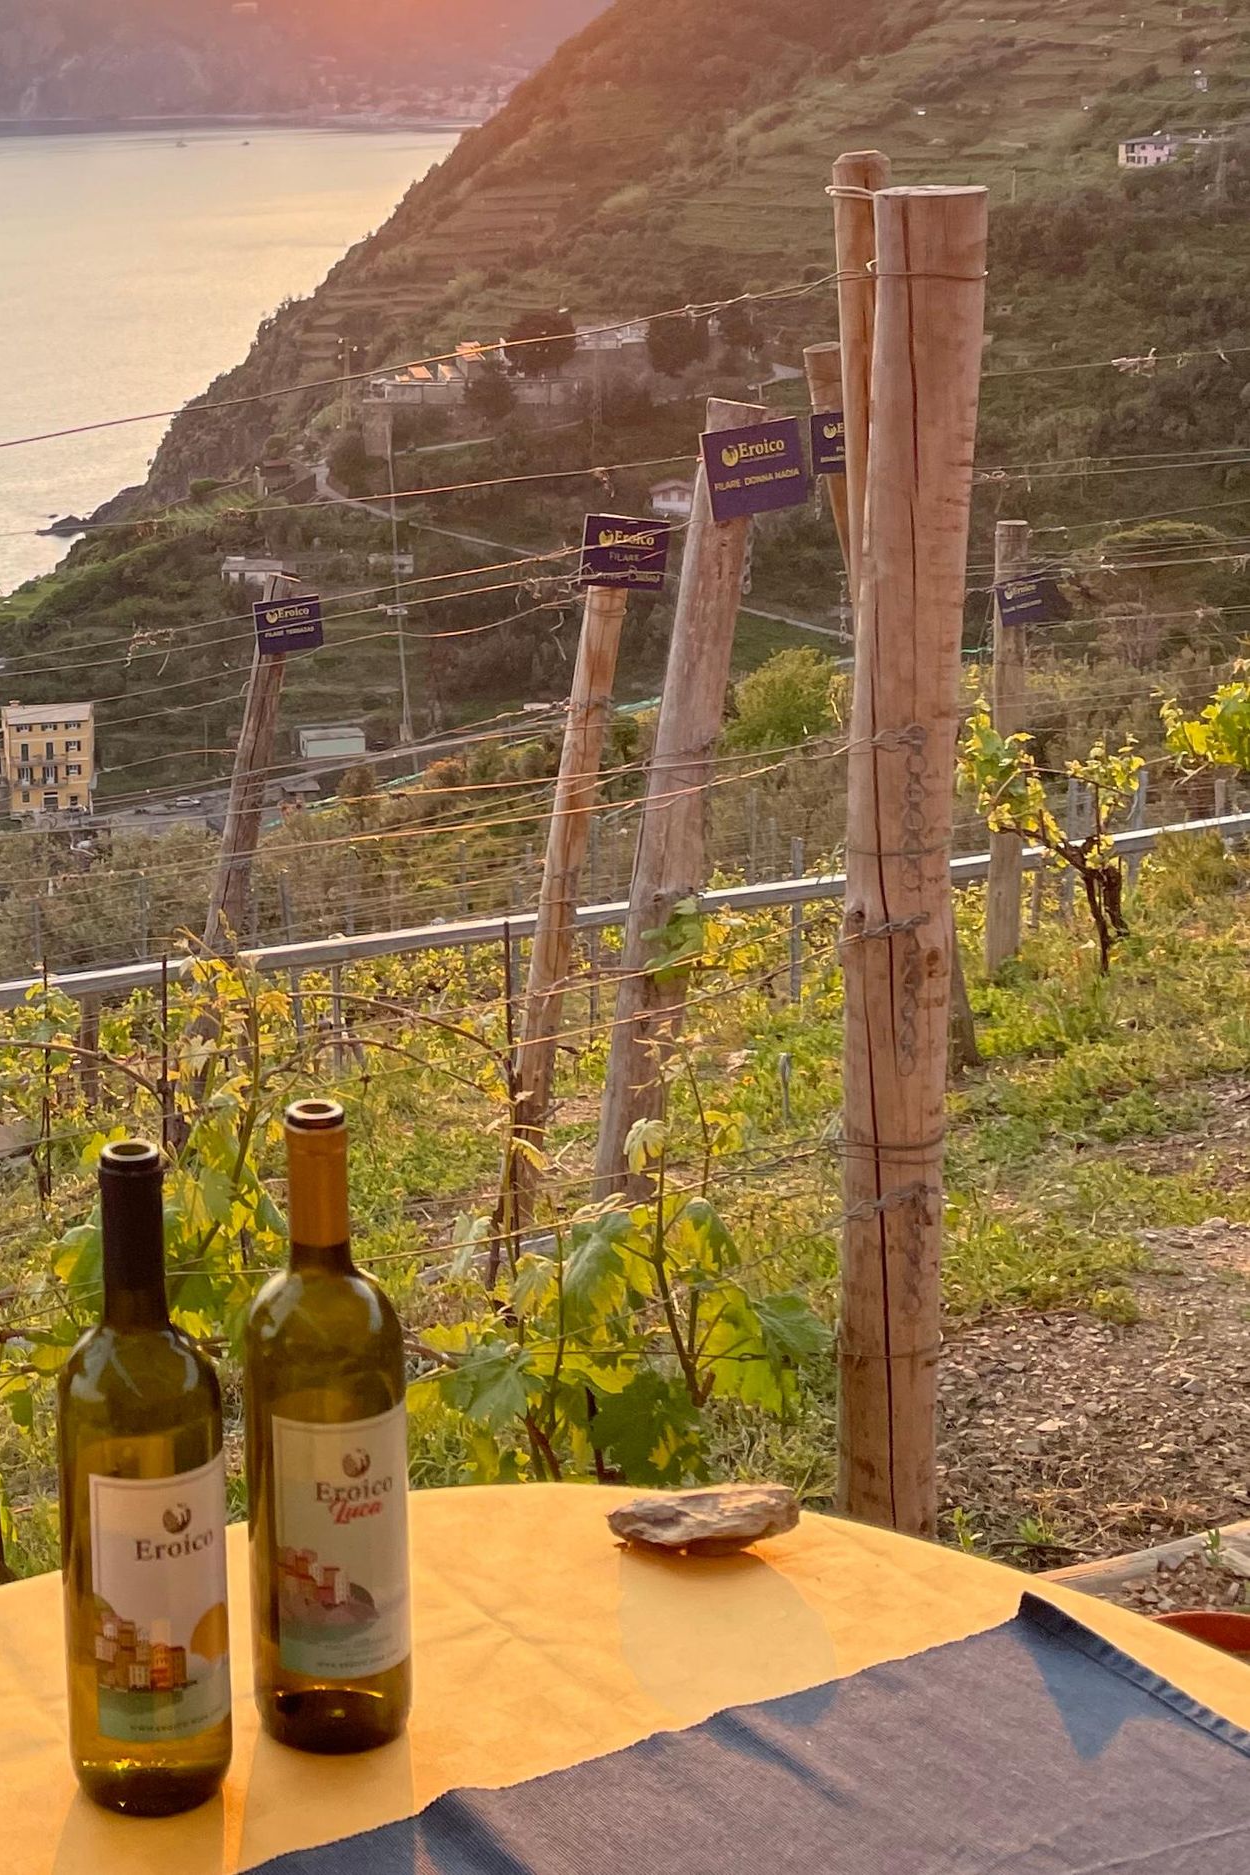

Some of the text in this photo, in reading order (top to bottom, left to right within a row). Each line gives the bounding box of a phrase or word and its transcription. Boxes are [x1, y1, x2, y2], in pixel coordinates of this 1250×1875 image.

[737, 438, 785, 458] Eroico
[713, 478, 741, 492] FILARE
[744, 472, 774, 486] DONNA
[278, 607, 309, 618] Eroico
[317, 1476, 393, 1503] Eroico
[329, 1499, 383, 1525] Luca
[135, 1528, 214, 1561] Eroico
